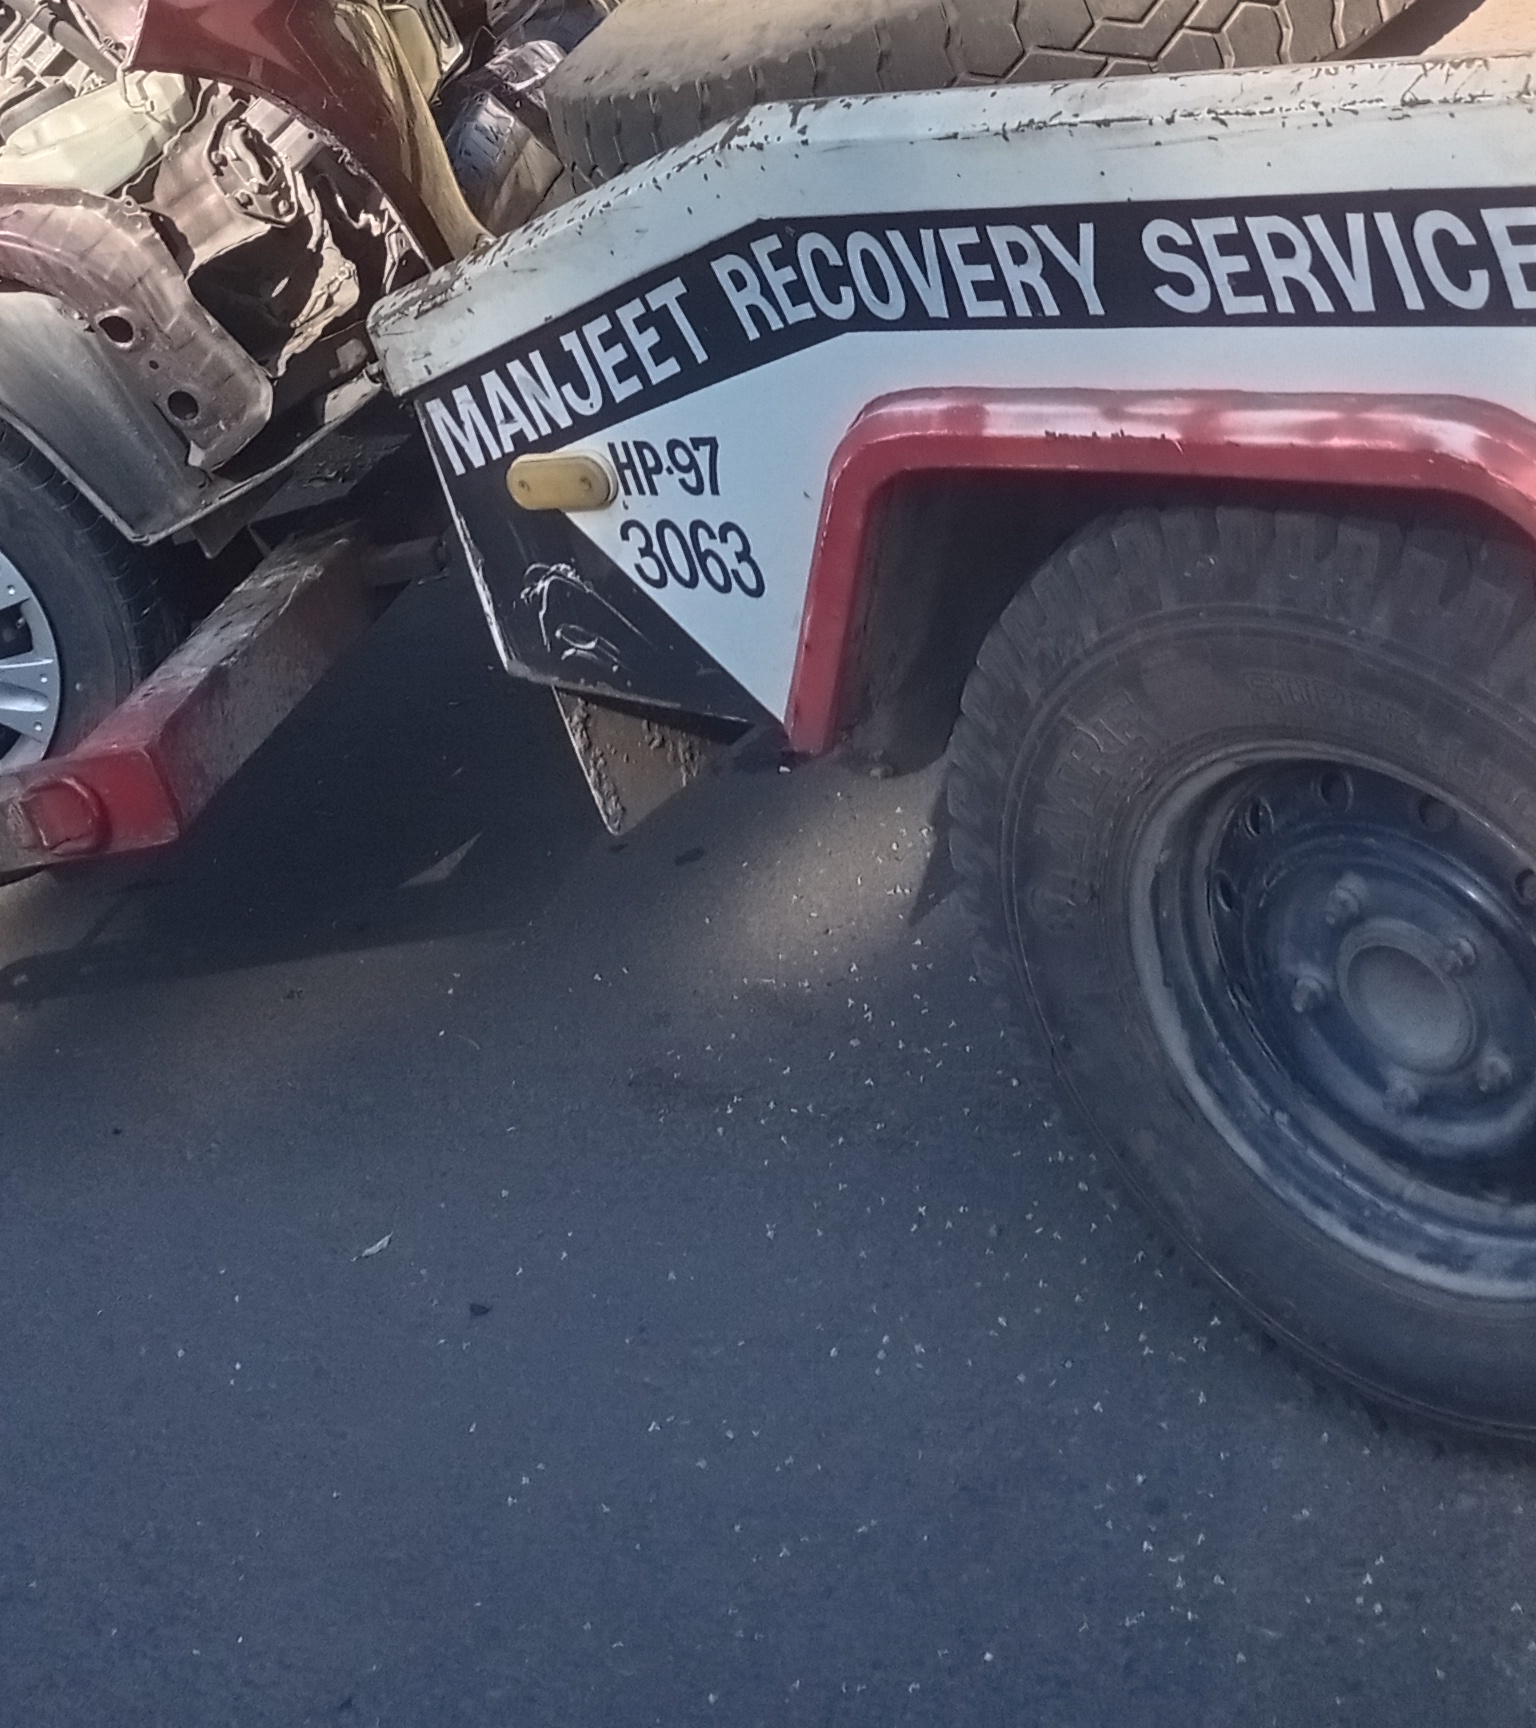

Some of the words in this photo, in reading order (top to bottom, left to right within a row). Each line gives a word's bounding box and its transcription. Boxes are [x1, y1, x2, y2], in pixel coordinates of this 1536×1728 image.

[424, 277, 709, 476] MANJEET
[710, 221, 1106, 342] RECOVERY
[619, 518, 766, 599] 3063
